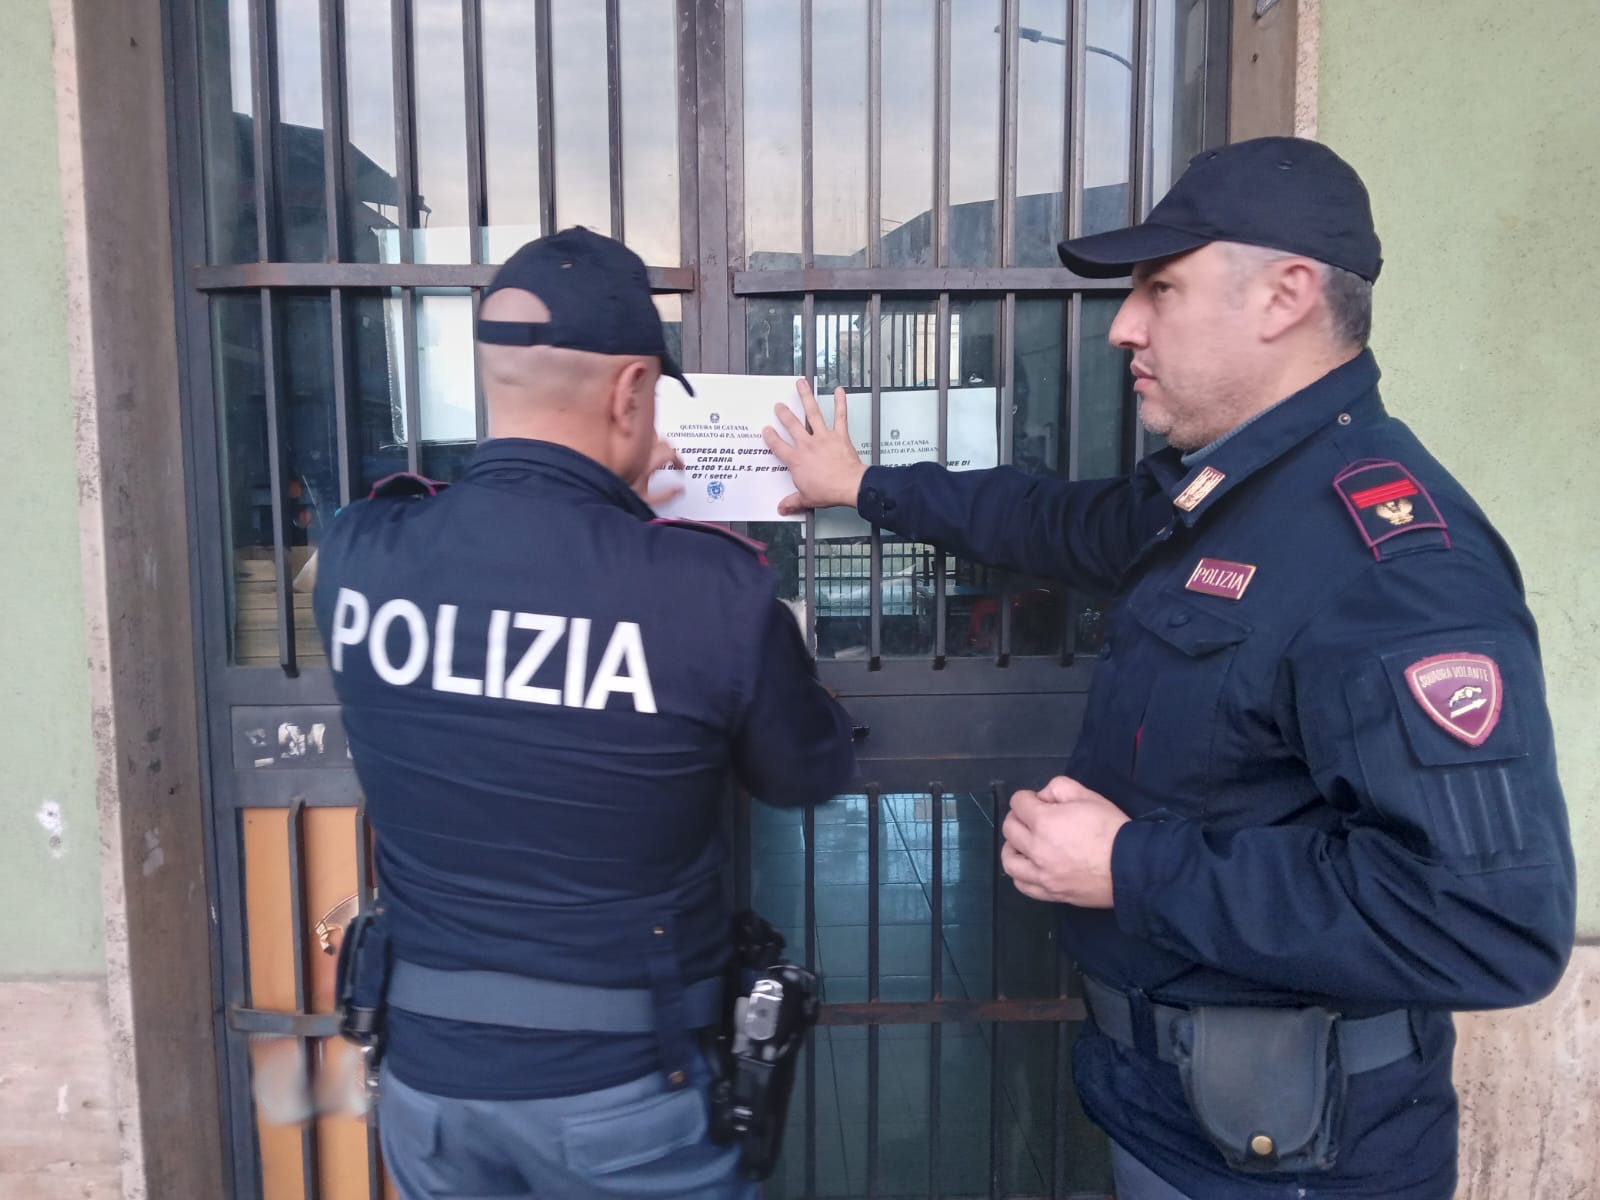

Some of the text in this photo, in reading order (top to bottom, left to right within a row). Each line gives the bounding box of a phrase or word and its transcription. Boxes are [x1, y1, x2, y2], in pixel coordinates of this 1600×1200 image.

[1192, 567, 1245, 591] POLIZIA
[331, 587, 658, 714] POLIZIA
[1452, 665, 1489, 682] VOLANTE
